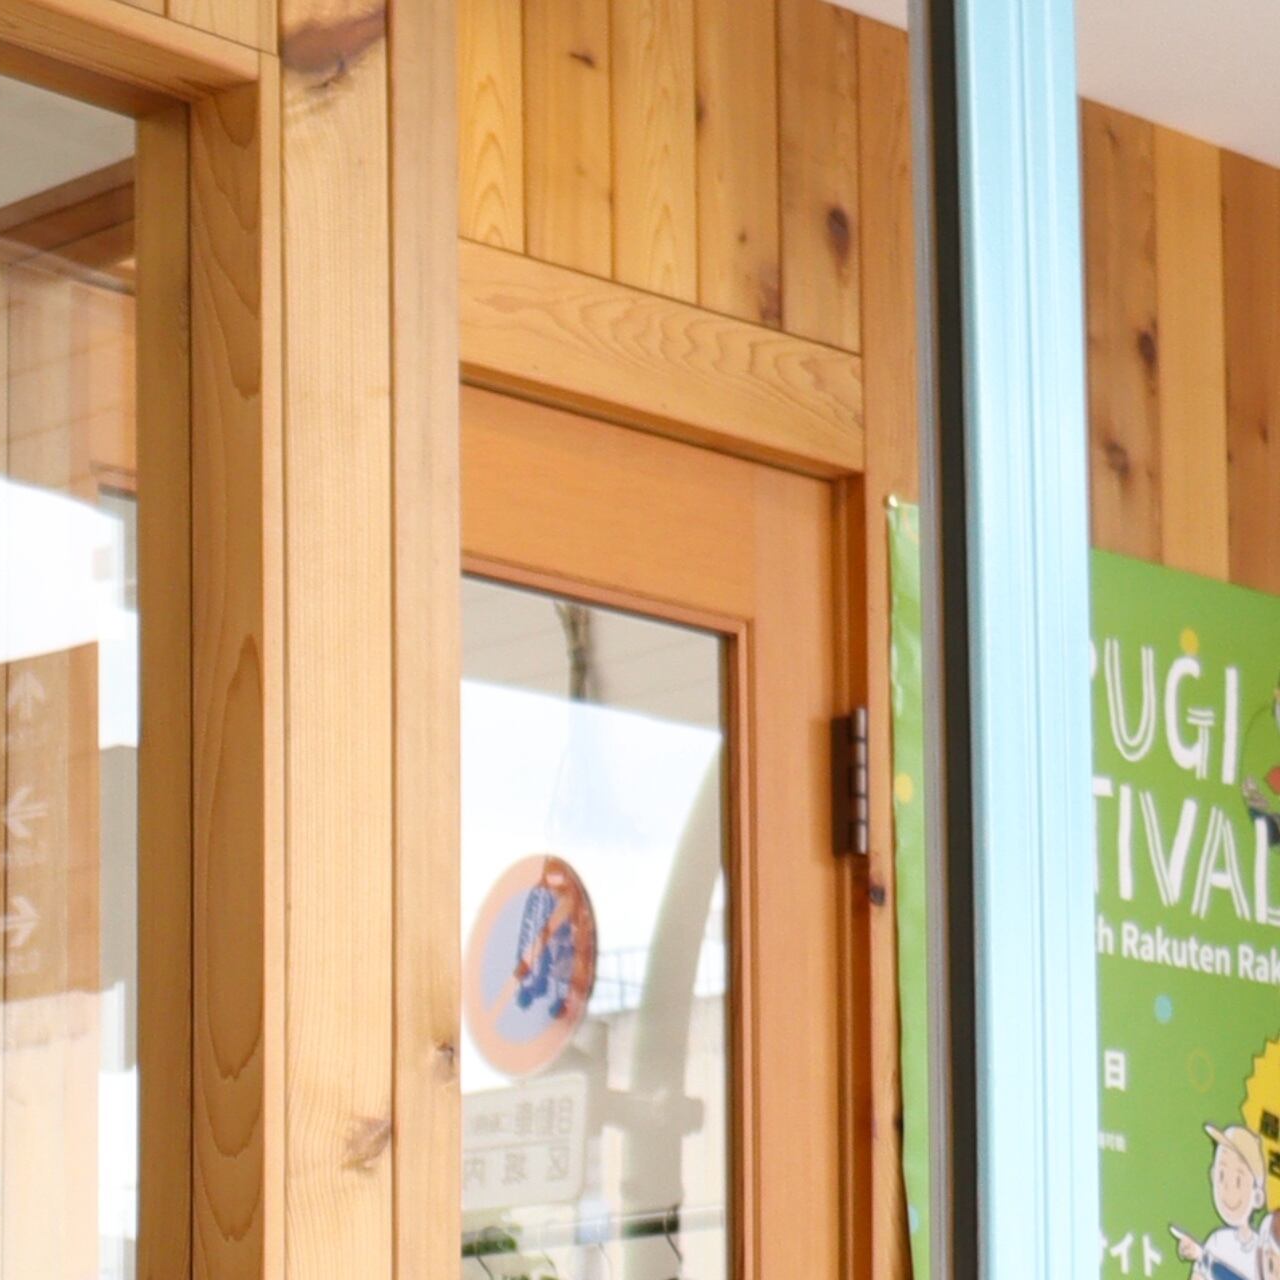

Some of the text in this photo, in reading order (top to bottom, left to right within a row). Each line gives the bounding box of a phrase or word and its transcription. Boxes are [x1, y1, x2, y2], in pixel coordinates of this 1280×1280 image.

[1089, 630, 1238, 786] UGI
[1121, 922, 1231, 977] Rakuten
[1104, 1050, 1126, 1091] 日
